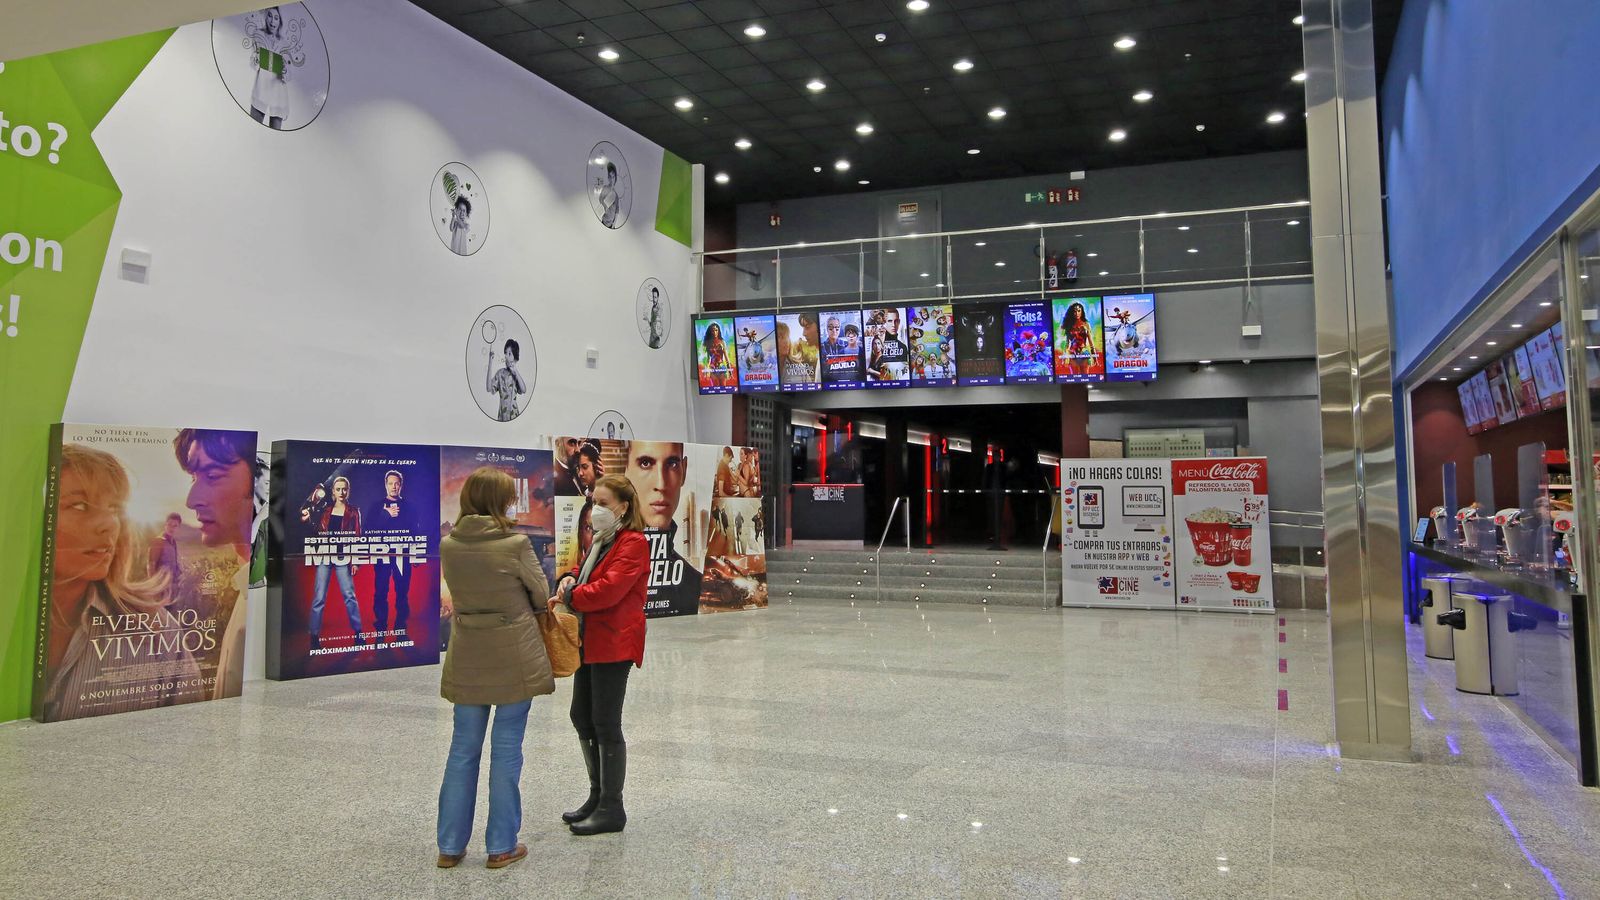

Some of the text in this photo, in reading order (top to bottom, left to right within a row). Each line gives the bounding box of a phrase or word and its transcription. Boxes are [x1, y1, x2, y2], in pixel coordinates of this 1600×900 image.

[830, 361, 856, 370] ABUELO
[1113, 360, 1148, 368] DRAGON
[1089, 467, 1122, 480] HAGAS
[1126, 467, 1162, 480] COLAS!
[829, 490, 844, 498] CINE
[645, 534, 667, 560] TA
[1074, 540, 1161, 551] COMPRA TUS ENTRADAS
[304, 543, 428, 570] MUERTE
[647, 560, 684, 587] IELO
[38, 580, 48, 664] NOVIEMBRE
[48, 514, 52, 531] EN
[1119, 580, 1139, 592] CINE
[655, 600, 670, 608] CINES
[92, 609, 216, 633] EL VERANO QUE
[90, 628, 216, 661] VIVIMOS
[310, 643, 375, 656] PRÓXIMAMENTE
[89, 686, 146, 700] NOVIEMBRE
[149, 682, 174, 692] SOLO
[176, 679, 188, 688] EN
[191, 676, 217, 686] CINES
